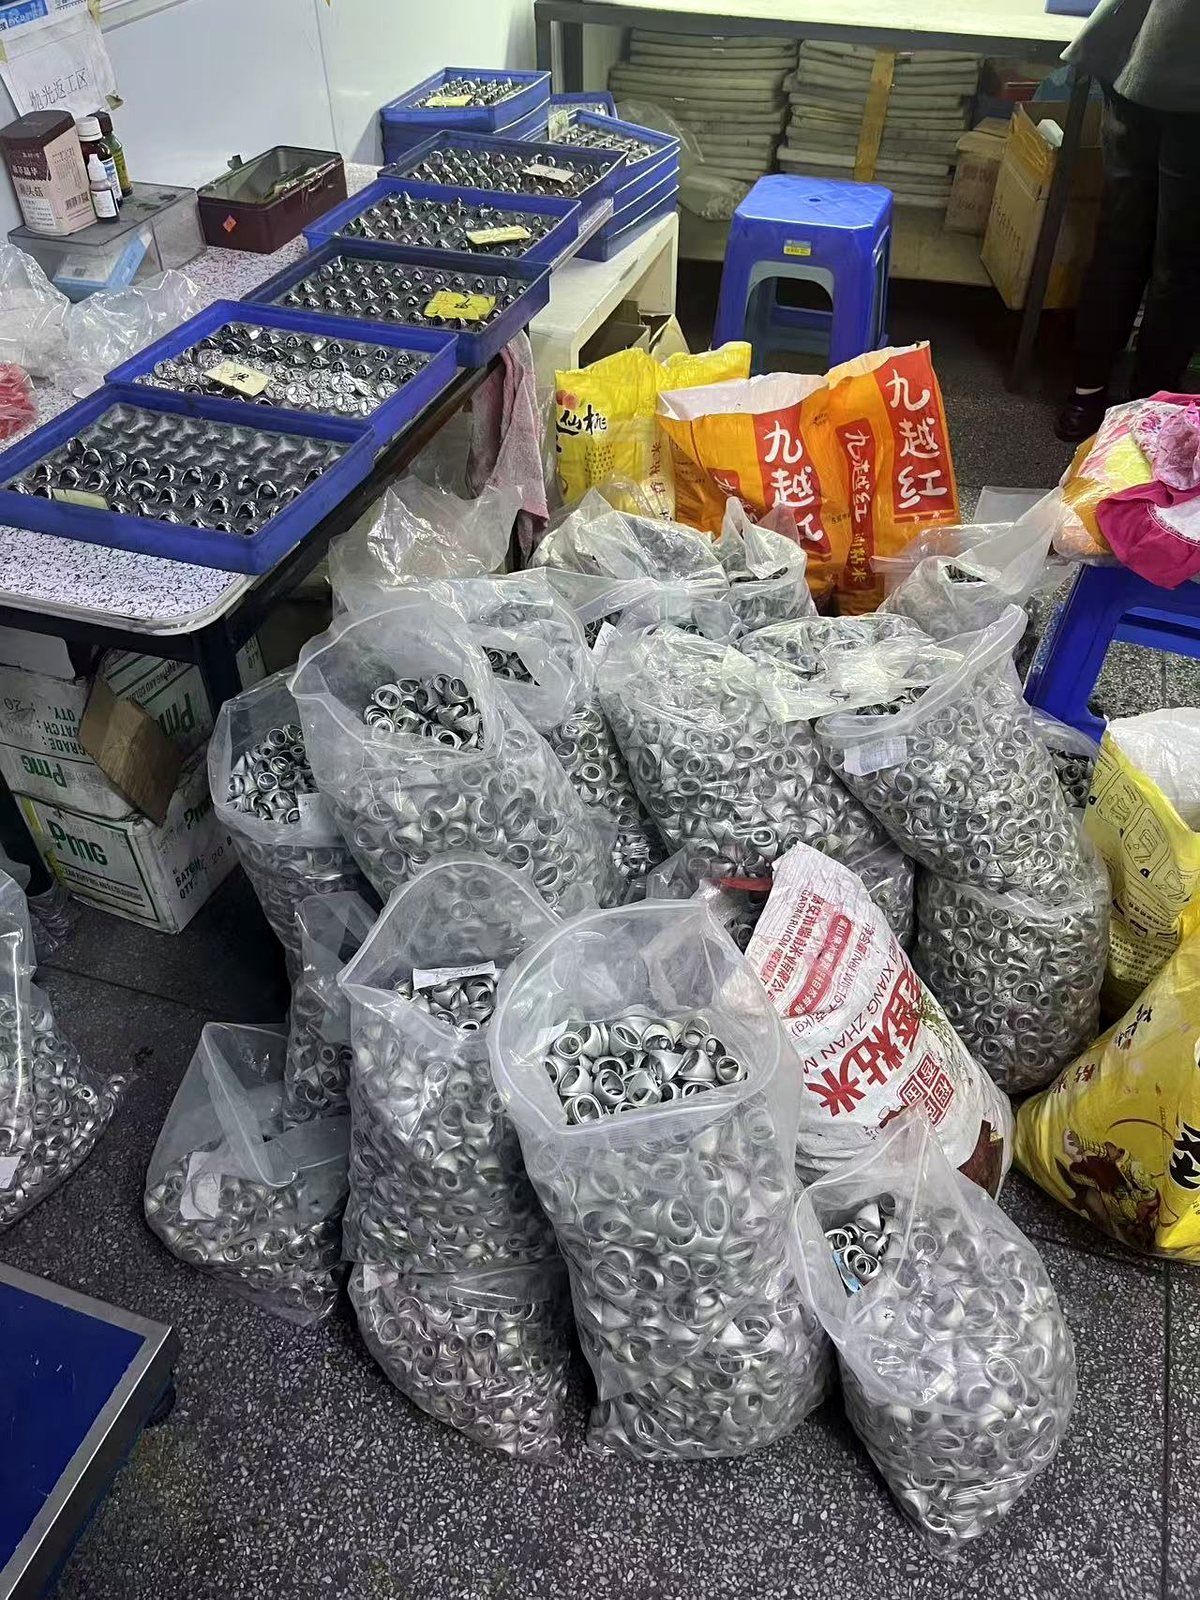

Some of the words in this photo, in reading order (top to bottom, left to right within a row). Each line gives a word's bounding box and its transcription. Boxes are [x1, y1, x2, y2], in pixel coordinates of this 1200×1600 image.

[29, 68, 88, 110] 抛光返工区
[556, 404, 607, 436] 仙桃
[885, 368, 948, 509] 九越红
[844, 429, 871, 523] 九越红
[867, 960, 895, 1016] XIANG
[821, 1011, 868, 1060] ZHAN
